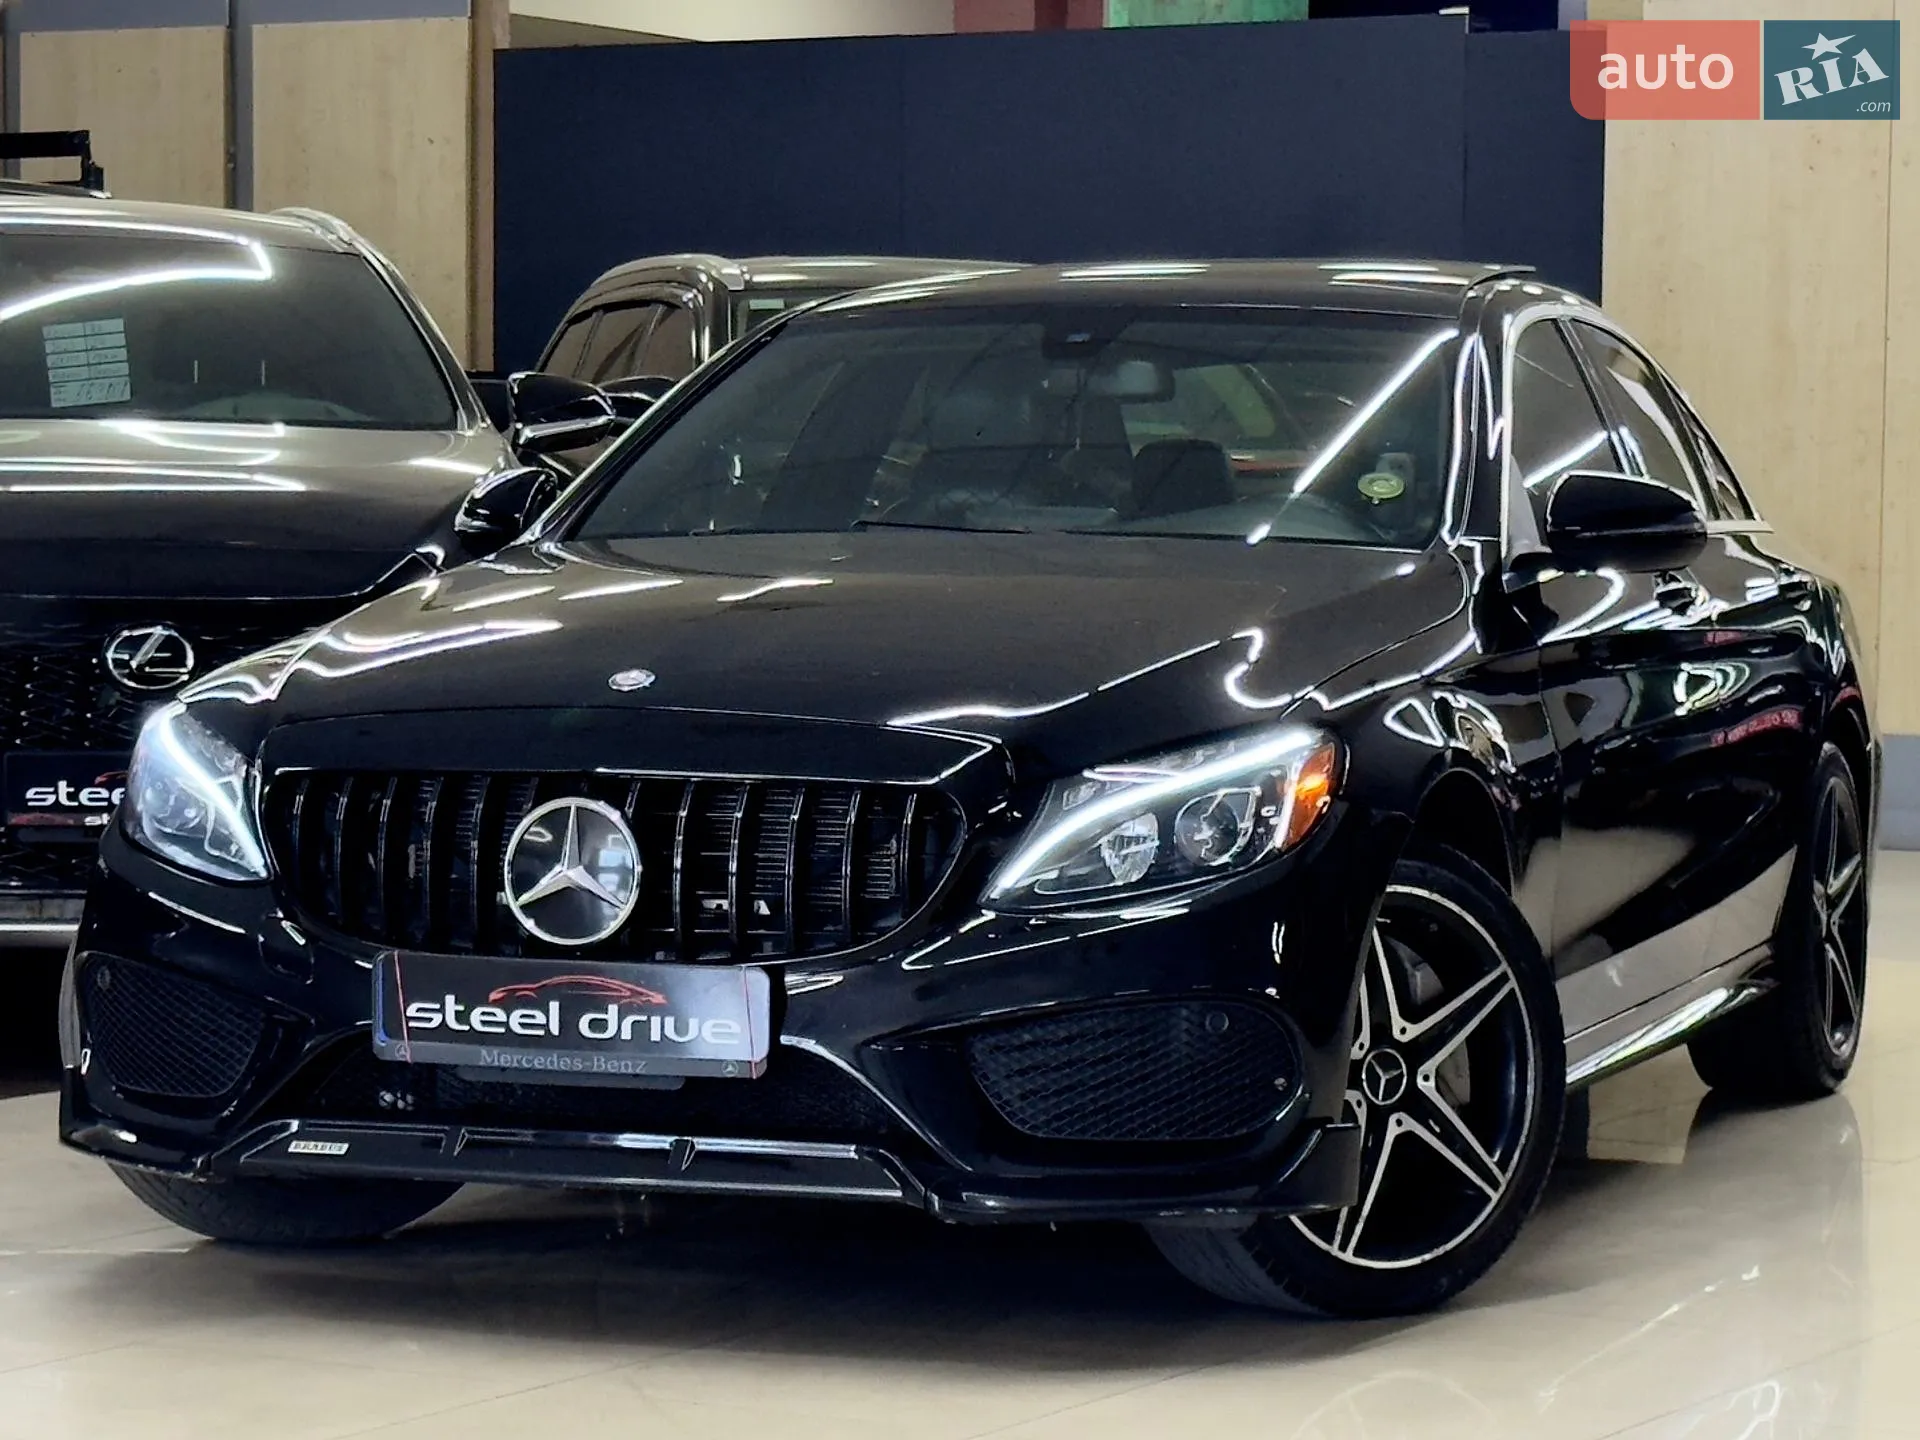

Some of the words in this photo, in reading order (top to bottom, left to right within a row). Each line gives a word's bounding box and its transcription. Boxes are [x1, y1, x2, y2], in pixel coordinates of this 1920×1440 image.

[406, 994, 560, 1037] steel
[578, 1004, 741, 1044] drive
[480, 1048, 648, 1074] Mercedes-Benz
